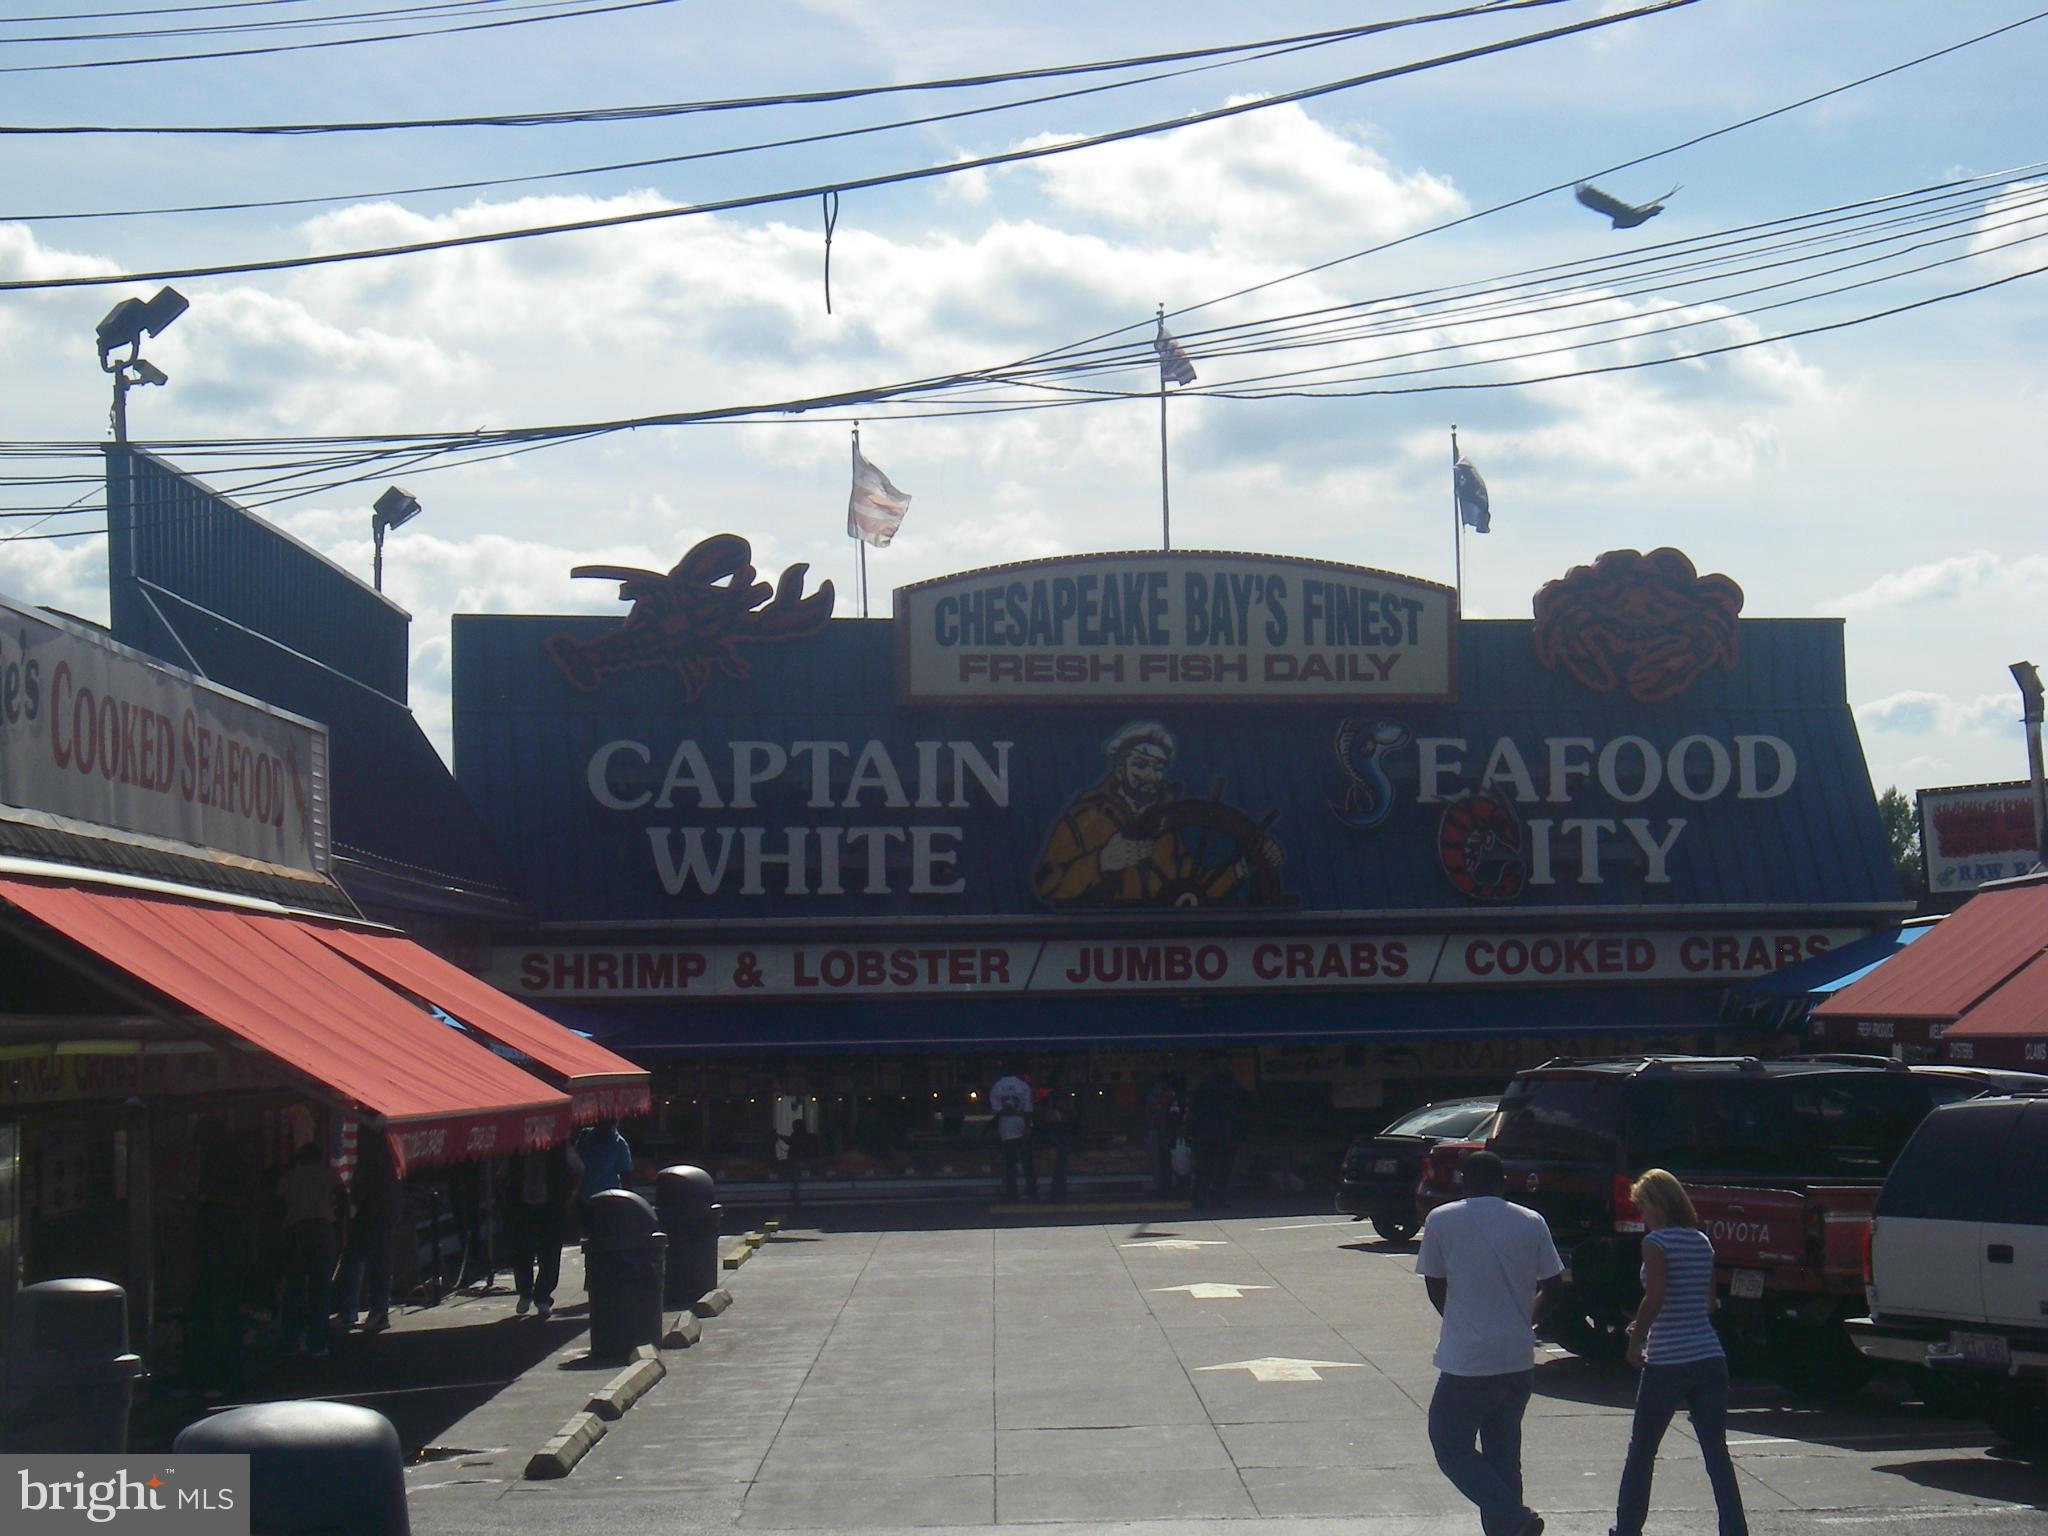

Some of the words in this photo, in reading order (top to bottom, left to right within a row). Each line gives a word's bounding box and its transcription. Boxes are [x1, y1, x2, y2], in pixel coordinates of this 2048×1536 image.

[934, 571, 1168, 647] CHESAPEAKE
[1184, 571, 1288, 647] BAY'S
[1304, 580, 1424, 647] FINEST
[959, 652, 1124, 682] FRESH
[1140, 653, 1248, 682] FISH
[1264, 652, 1400, 682] DAILY
[0, 628, 40, 724] e's
[51, 660, 175, 794] COOKED
[180, 707, 285, 828] SEAFOOD
[587, 739, 1014, 810] CAPTAIN
[645, 826, 967, 895] WHITE
[521, 952, 707, 991] SHRIMP
[733, 951, 764, 988] &
[793, 948, 1010, 987] LOBSTER
[1066, 944, 1228, 983] JUMBO
[1252, 941, 1409, 979] CRABS
[1465, 937, 1656, 976] COOKED
[1704, 1220, 1770, 1243] TOYOTA
